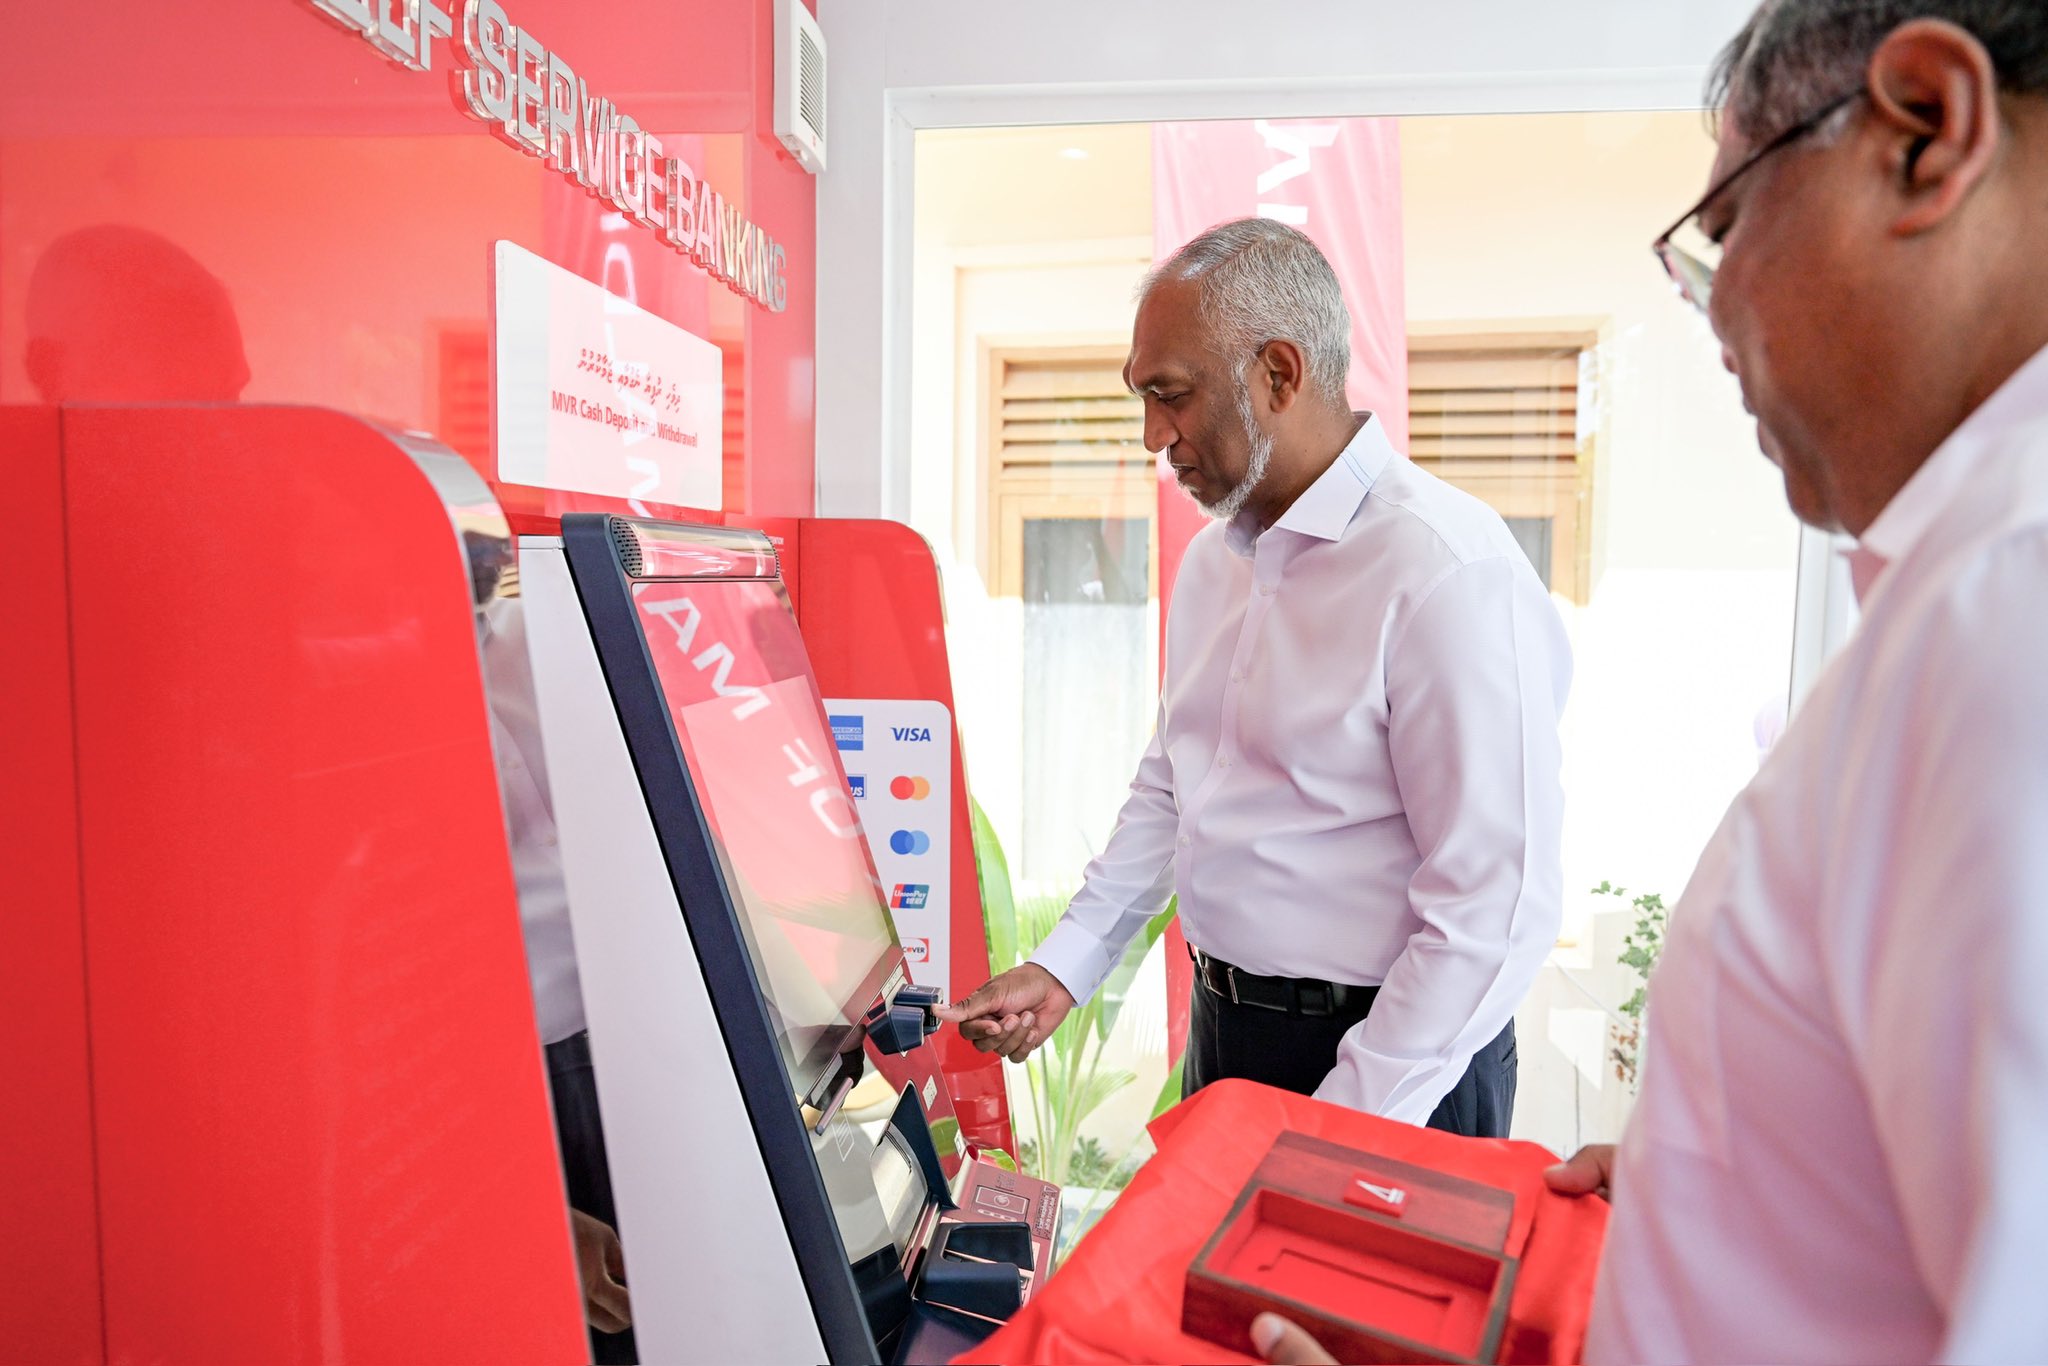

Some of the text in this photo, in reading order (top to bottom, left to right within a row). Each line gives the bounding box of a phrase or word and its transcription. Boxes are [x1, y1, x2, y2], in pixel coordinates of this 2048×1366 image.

[463, 0, 667, 230] SERVICE
[668, 158, 786, 313] BANKING
[552, 391, 577, 415] MVR
[580, 399, 602, 423] Cash
[657, 422, 698, 448] Withdrawal
[890, 727, 931, 742] VISA
